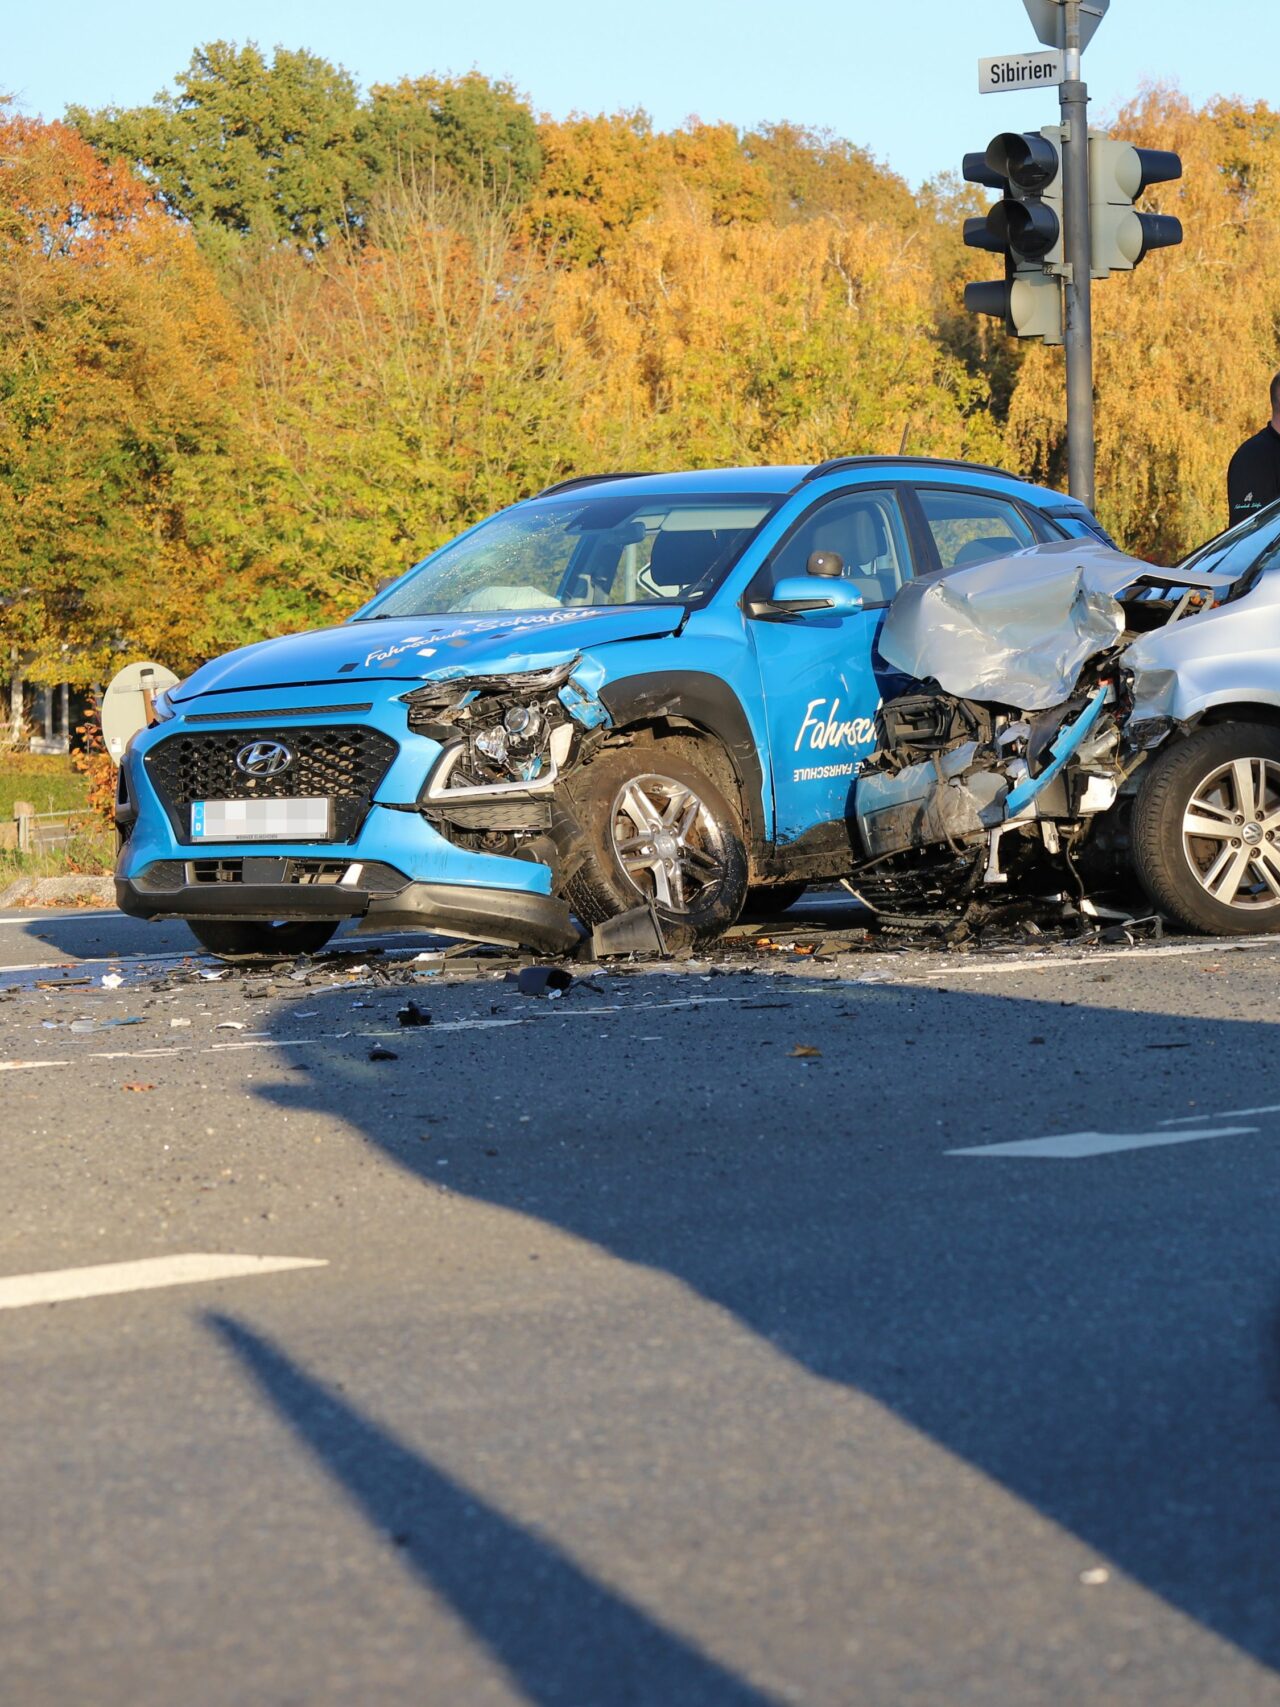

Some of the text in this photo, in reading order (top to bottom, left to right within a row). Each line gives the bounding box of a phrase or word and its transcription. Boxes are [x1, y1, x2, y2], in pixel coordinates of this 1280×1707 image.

[990, 60, 1052, 84] Sibirien
[365, 629, 471, 667] Fahrschule
[793, 763, 853, 782] FAHRSCHULE
